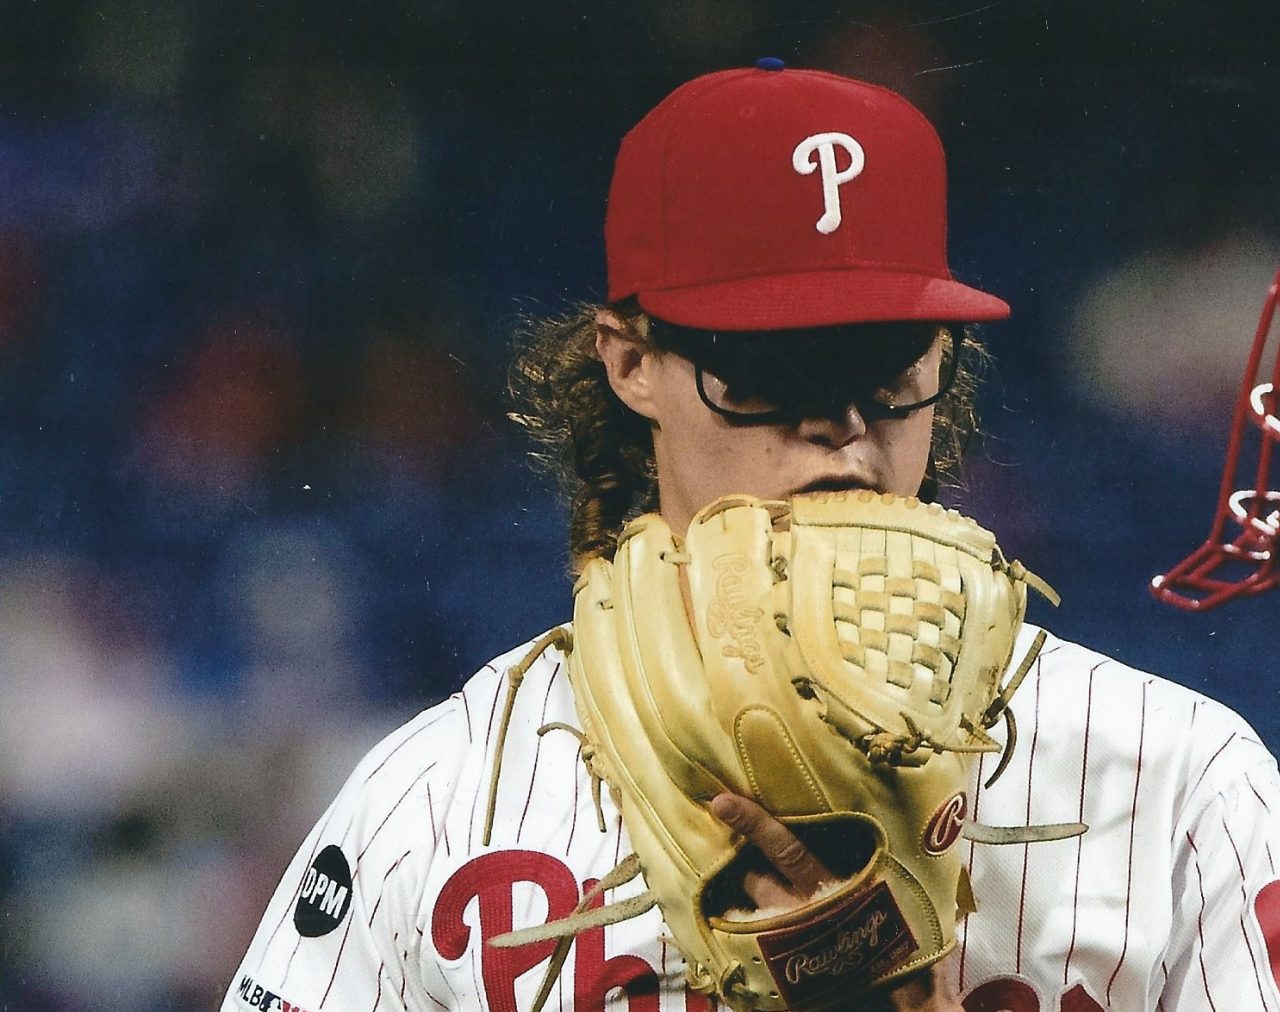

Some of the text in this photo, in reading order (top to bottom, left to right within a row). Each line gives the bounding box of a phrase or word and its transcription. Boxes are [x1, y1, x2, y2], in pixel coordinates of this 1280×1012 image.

[792, 132, 865, 234] P
[301, 867, 348, 919] DPM
[785, 910, 886, 984] Rawlings
[236, 974, 264, 1006] MLB
